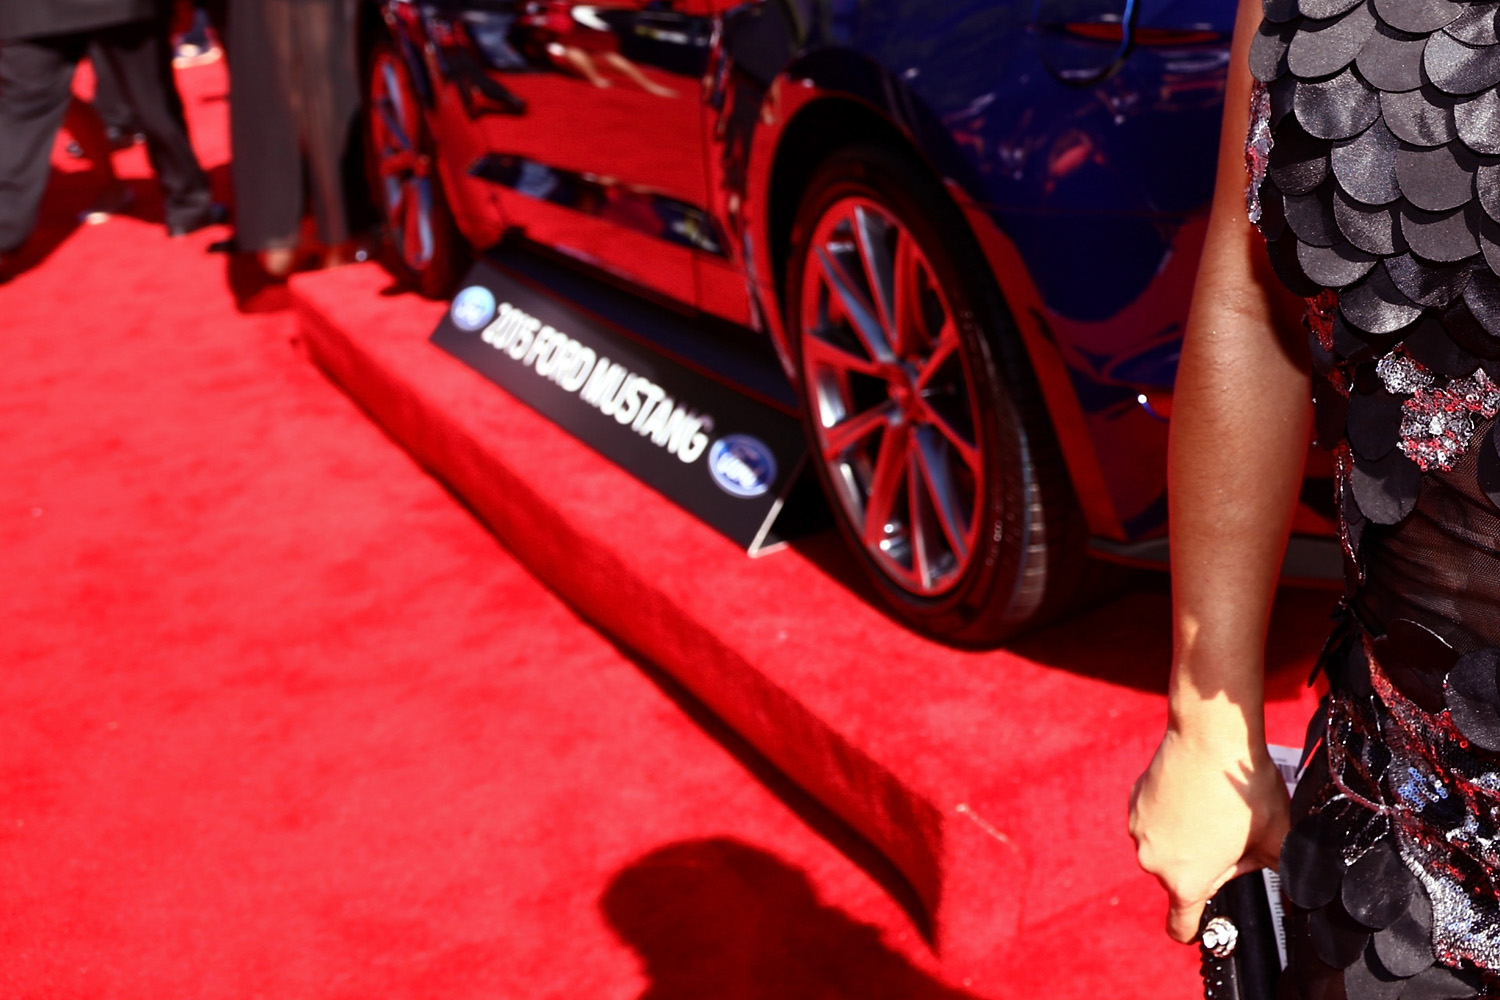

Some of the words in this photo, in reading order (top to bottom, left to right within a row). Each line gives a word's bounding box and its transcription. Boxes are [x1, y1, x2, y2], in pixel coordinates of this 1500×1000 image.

[482, 302, 541, 360] 2015
[523, 325, 597, 392] FORD
[579, 356, 714, 464] MUSTANG
